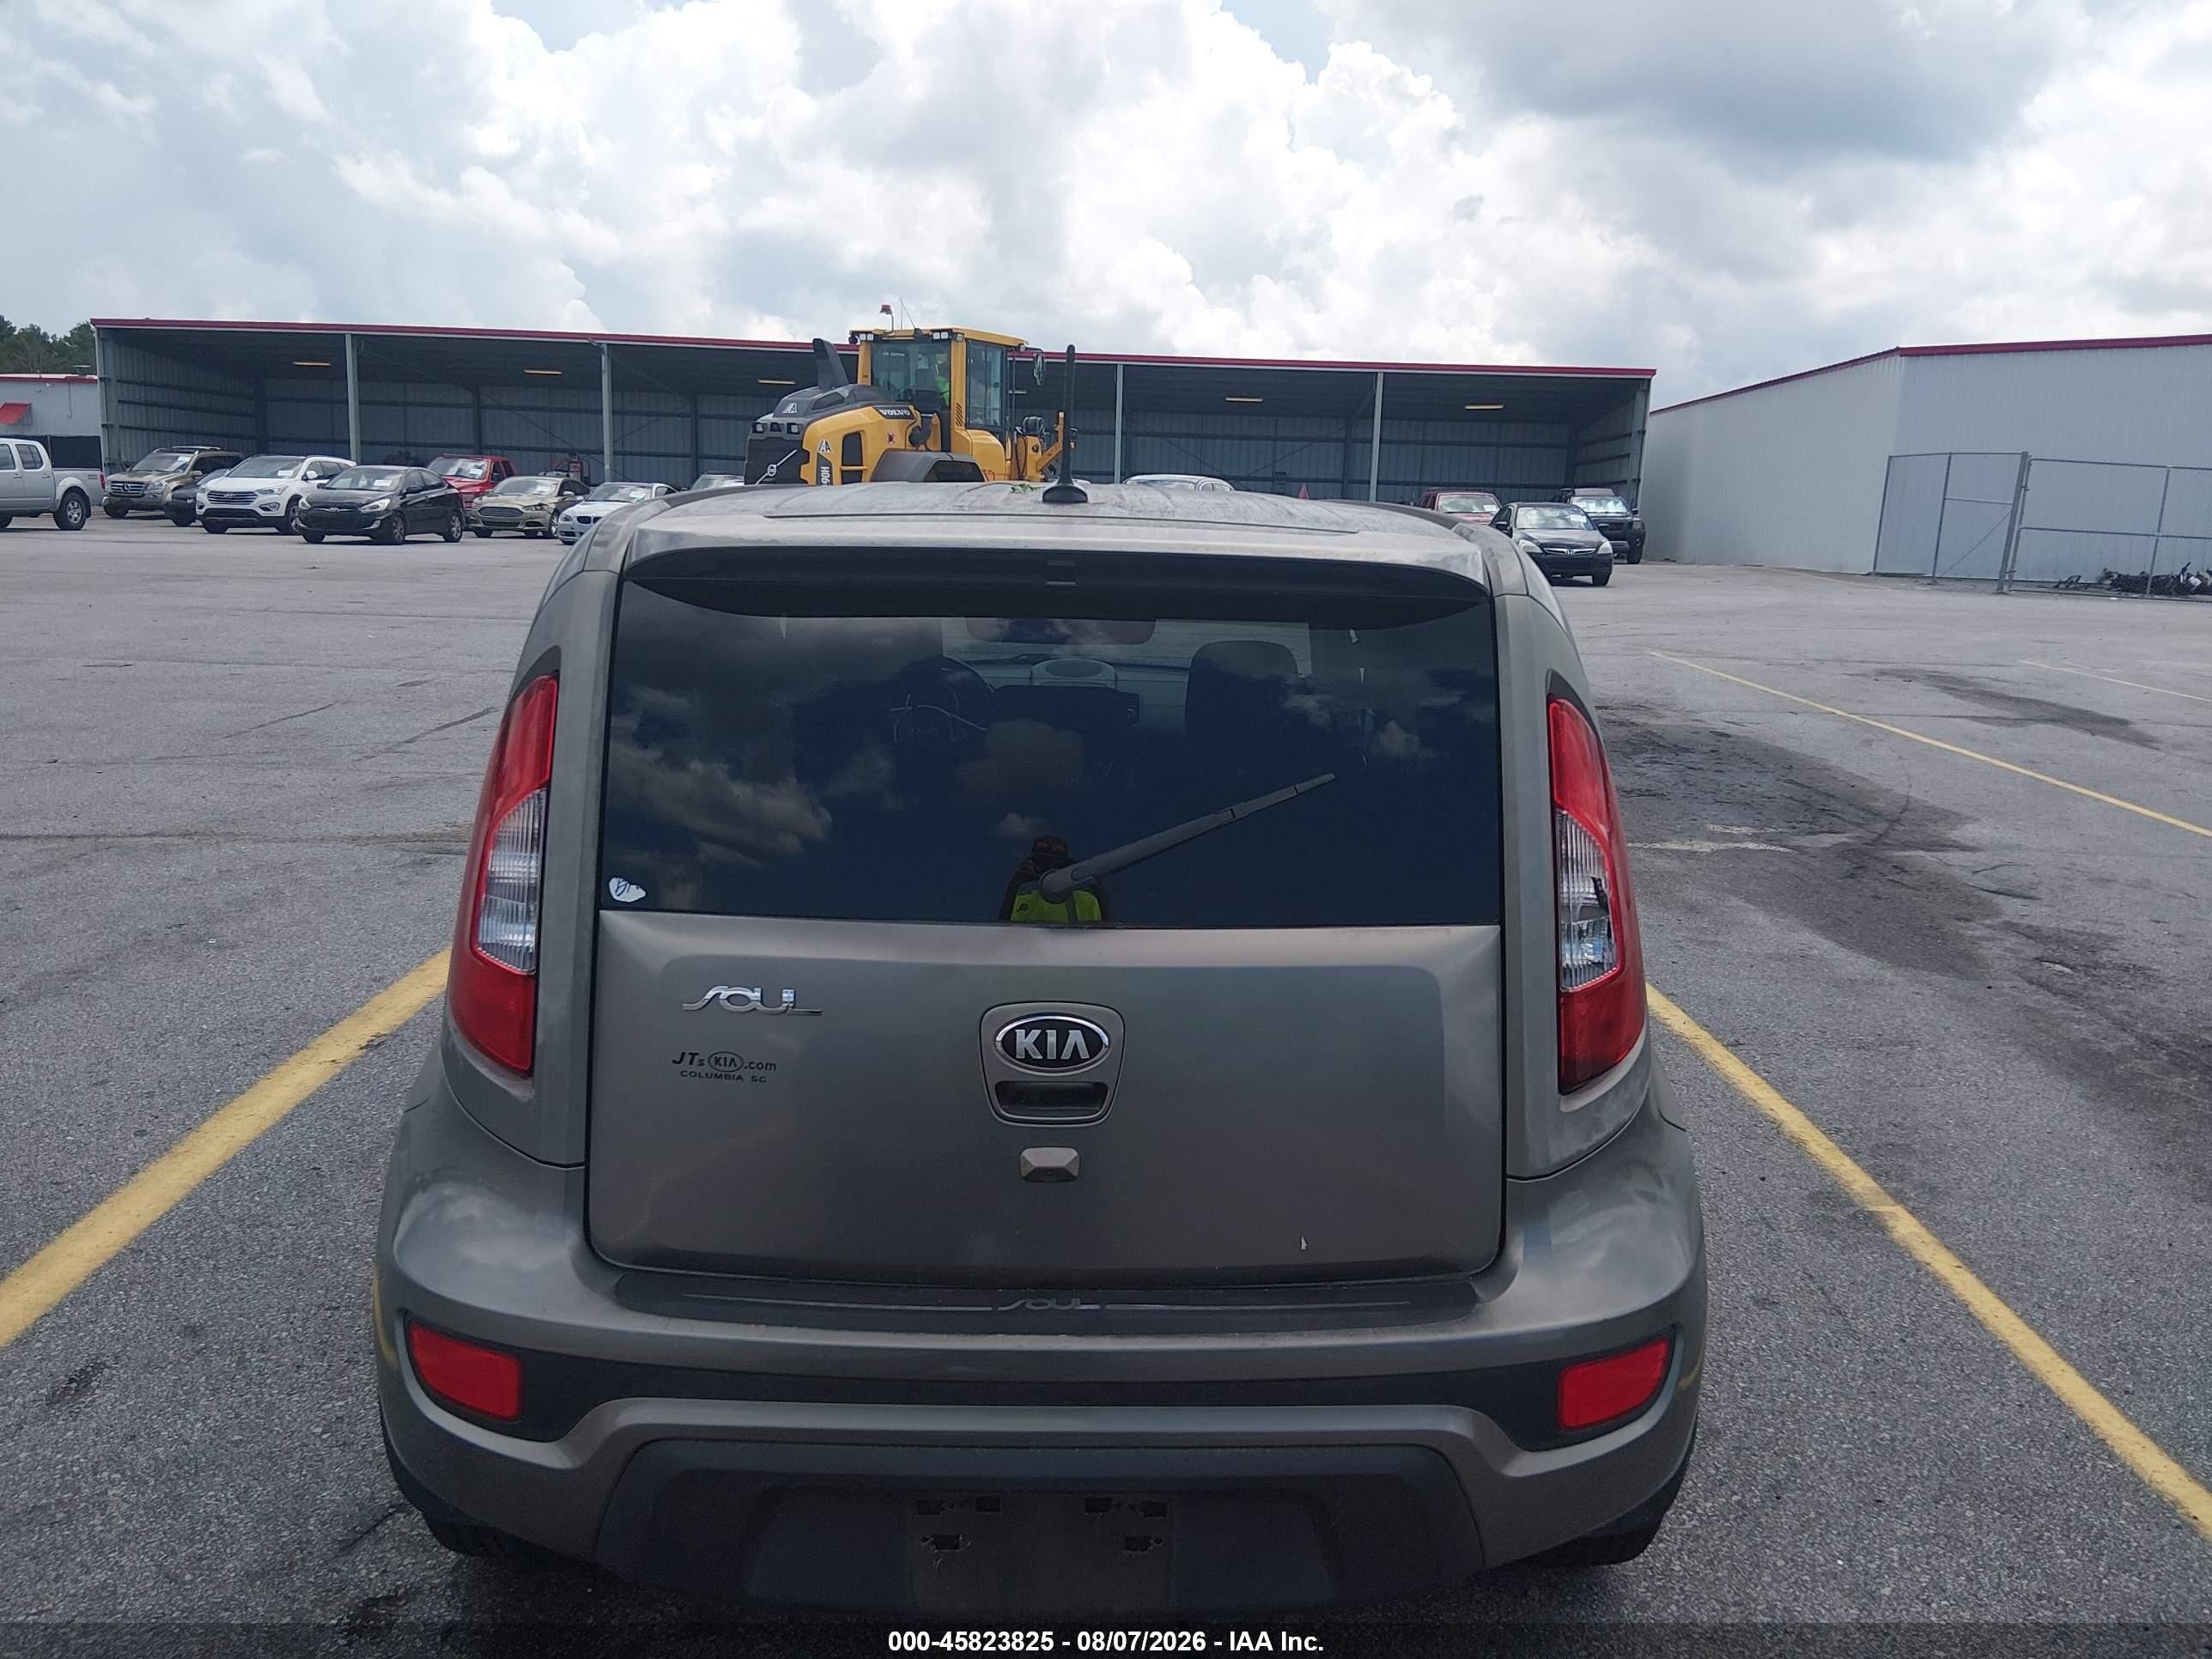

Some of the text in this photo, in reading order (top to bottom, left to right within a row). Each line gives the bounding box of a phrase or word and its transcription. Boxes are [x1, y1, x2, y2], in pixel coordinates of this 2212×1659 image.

[682, 985, 823, 1016] SOUL
[1015, 1029, 1090, 1060] KIA
[679, 1070, 744, 1082] COLUMBIA
